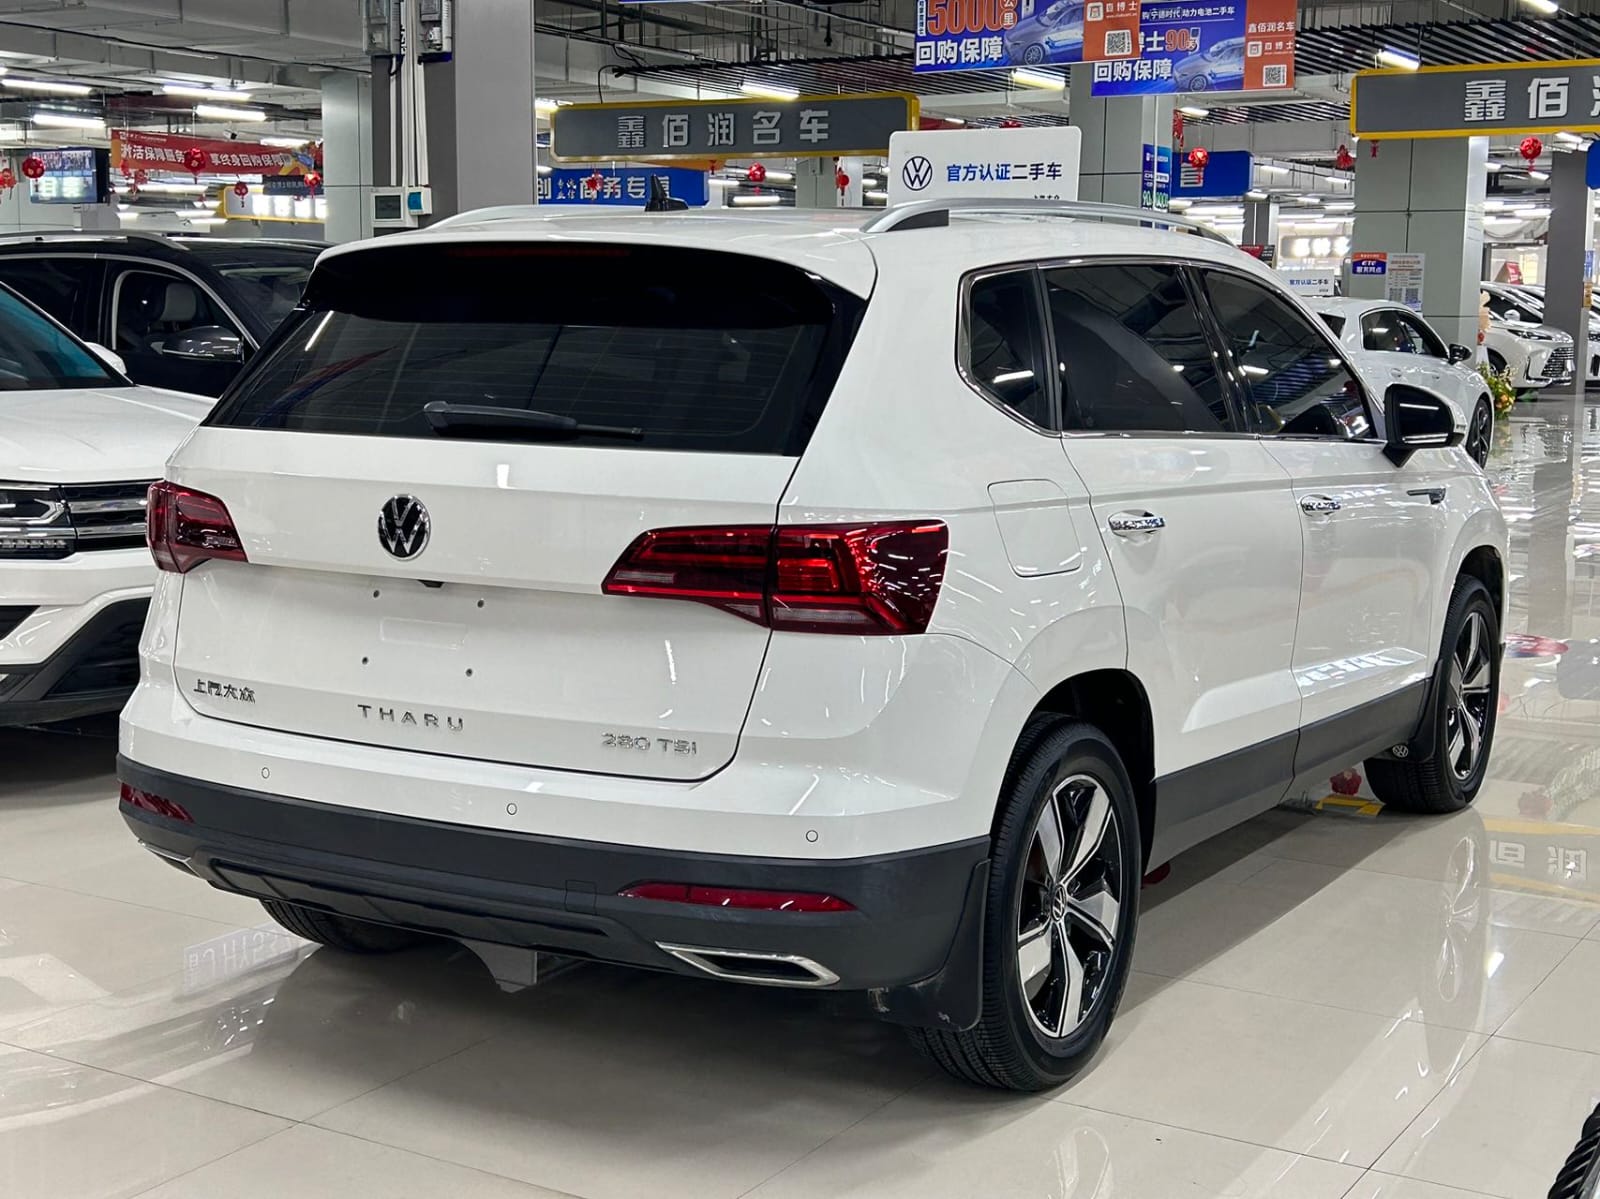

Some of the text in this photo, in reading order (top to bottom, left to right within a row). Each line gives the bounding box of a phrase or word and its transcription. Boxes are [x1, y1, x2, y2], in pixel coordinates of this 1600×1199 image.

[915, 37, 1003, 66] 回购保障
[1094, 59, 1172, 83] 回购保障
[1464, 74, 1600, 122] 鑫佰
[617, 109, 830, 149] 鑫佰润名车
[946, 162, 1062, 182] 官方认证二手车
[193, 678, 255, 704] 上汽大众
[357, 704, 464, 731] THARU
[601, 732, 697, 754] 280 TSI
